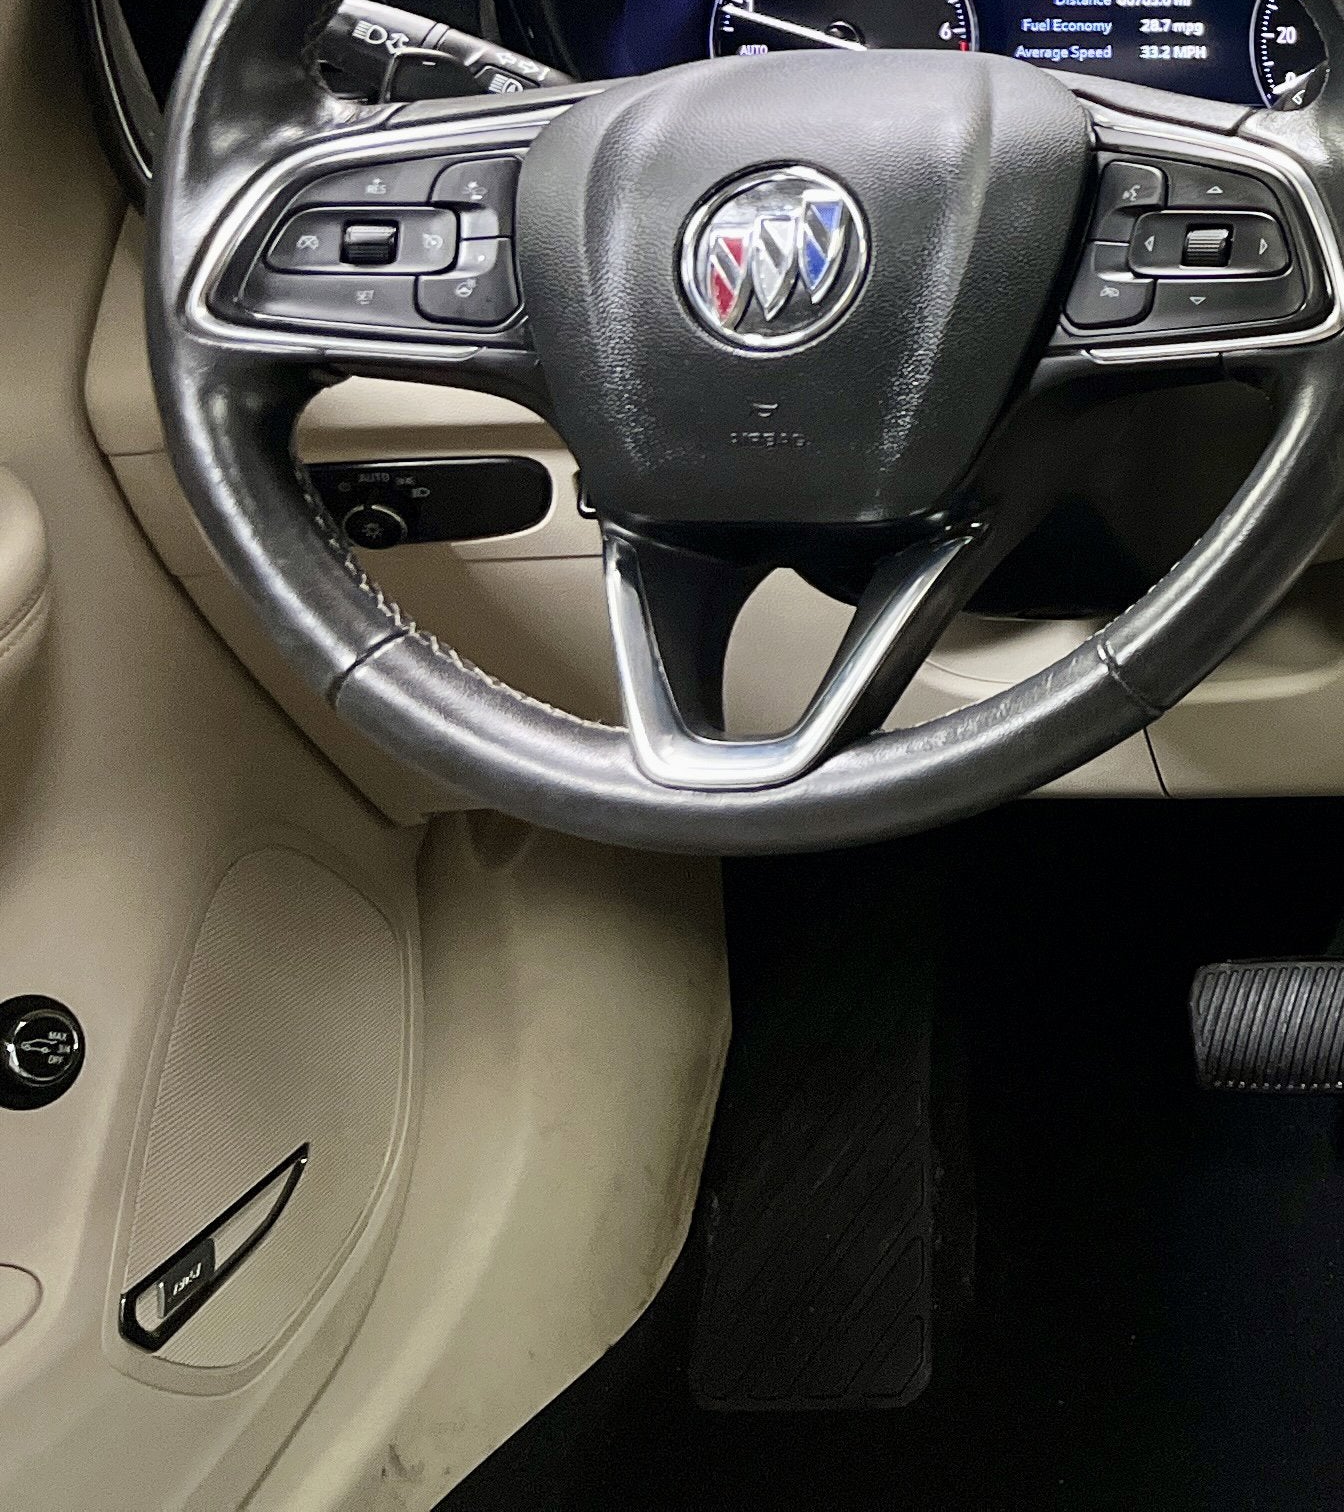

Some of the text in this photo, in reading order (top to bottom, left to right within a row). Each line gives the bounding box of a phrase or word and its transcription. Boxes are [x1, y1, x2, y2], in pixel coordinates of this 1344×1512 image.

[938, 22, 952, 41] 6
[1021, 18, 1205, 37] Fuel Economy 28.7 mpg
[1276, 26, 1298, 44] 20
[738, 44, 769, 56] AUTO
[1014, 45, 1208, 63] Average Speed 33.2 MPH
[48, 1030, 67, 1041] MAX
